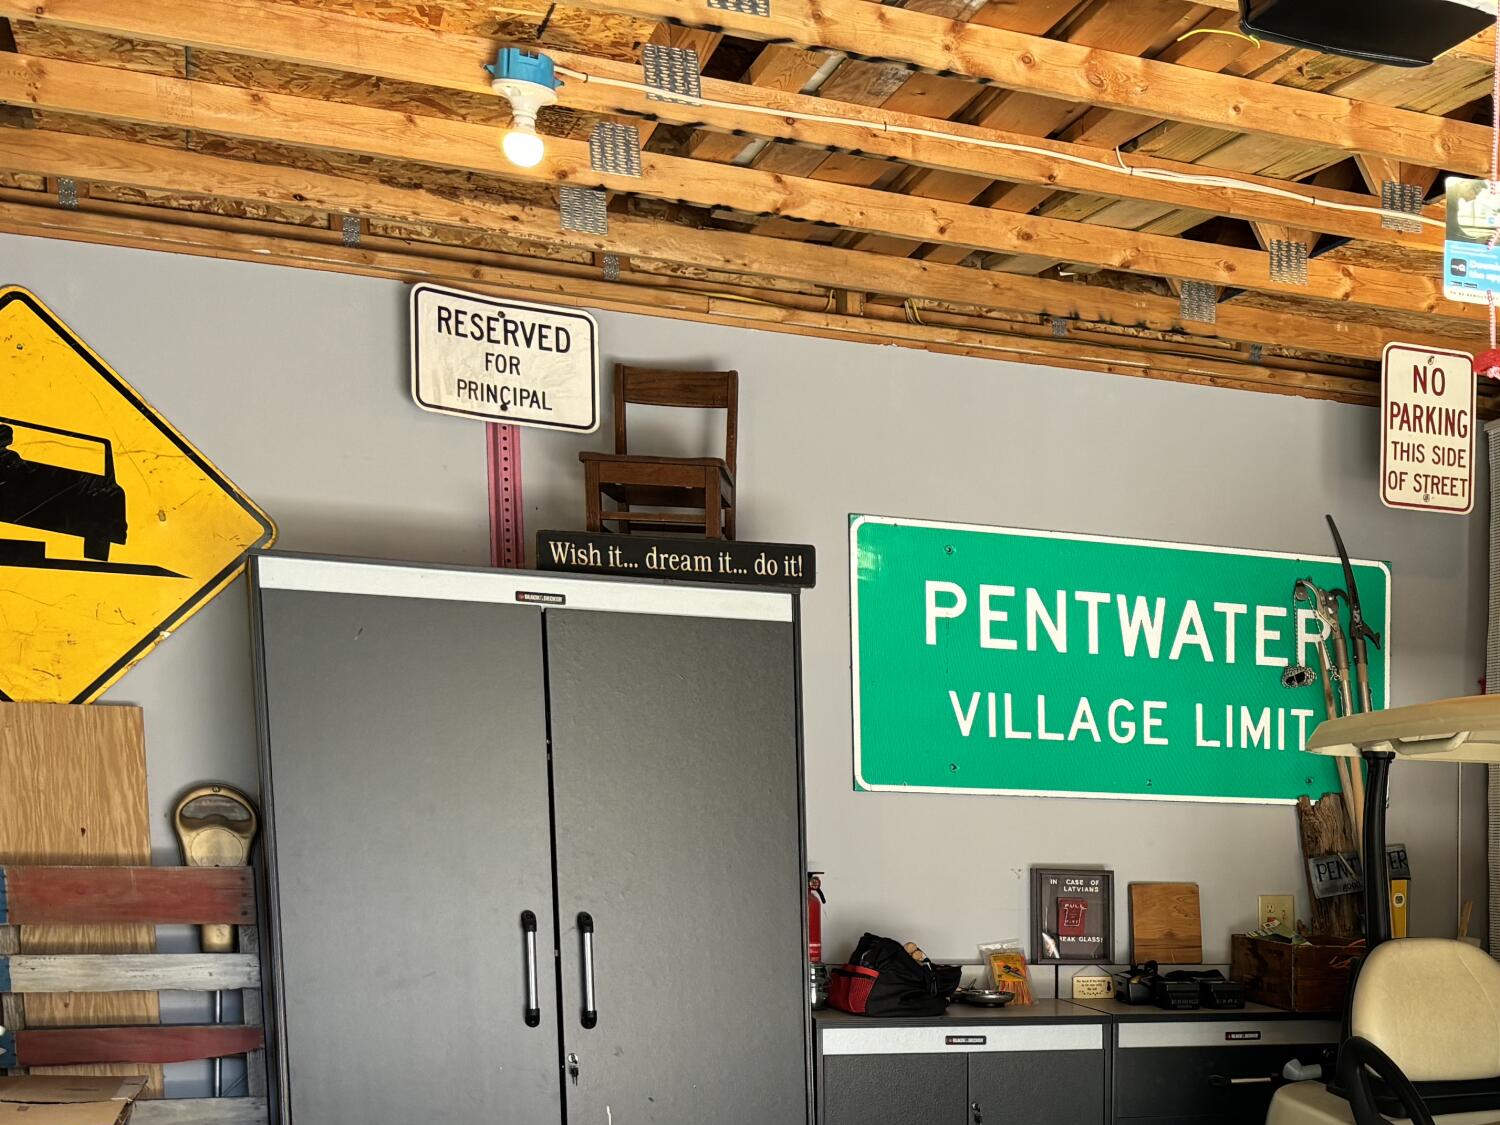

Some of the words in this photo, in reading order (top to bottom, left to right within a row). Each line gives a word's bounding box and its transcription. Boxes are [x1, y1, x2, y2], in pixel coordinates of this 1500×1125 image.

[437, 305, 571, 353] RESERVED
[485, 352, 520, 376] FOR
[1413, 364, 1446, 397] NO
[457, 378, 553, 411] PRINCIPAL
[1389, 401, 1468, 438] PARKING
[1391, 441, 1425, 463] THIS
[1432, 445, 1466, 468] SIDE
[1387, 470, 1408, 490] OF
[1413, 473, 1468, 498] STREET
[549, 540, 602, 567] Wish
[608, 544, 639, 568] it...
[645, 545, 713, 573] dream
[717, 551, 748, 575] it...
[754, 552, 779, 576] do
[783, 554, 804, 577] it!
[925, 580, 1332, 669] PENTWATER
[948, 690, 1169, 745] VILLAGE
[1196, 703, 1314, 751] LIMIT
